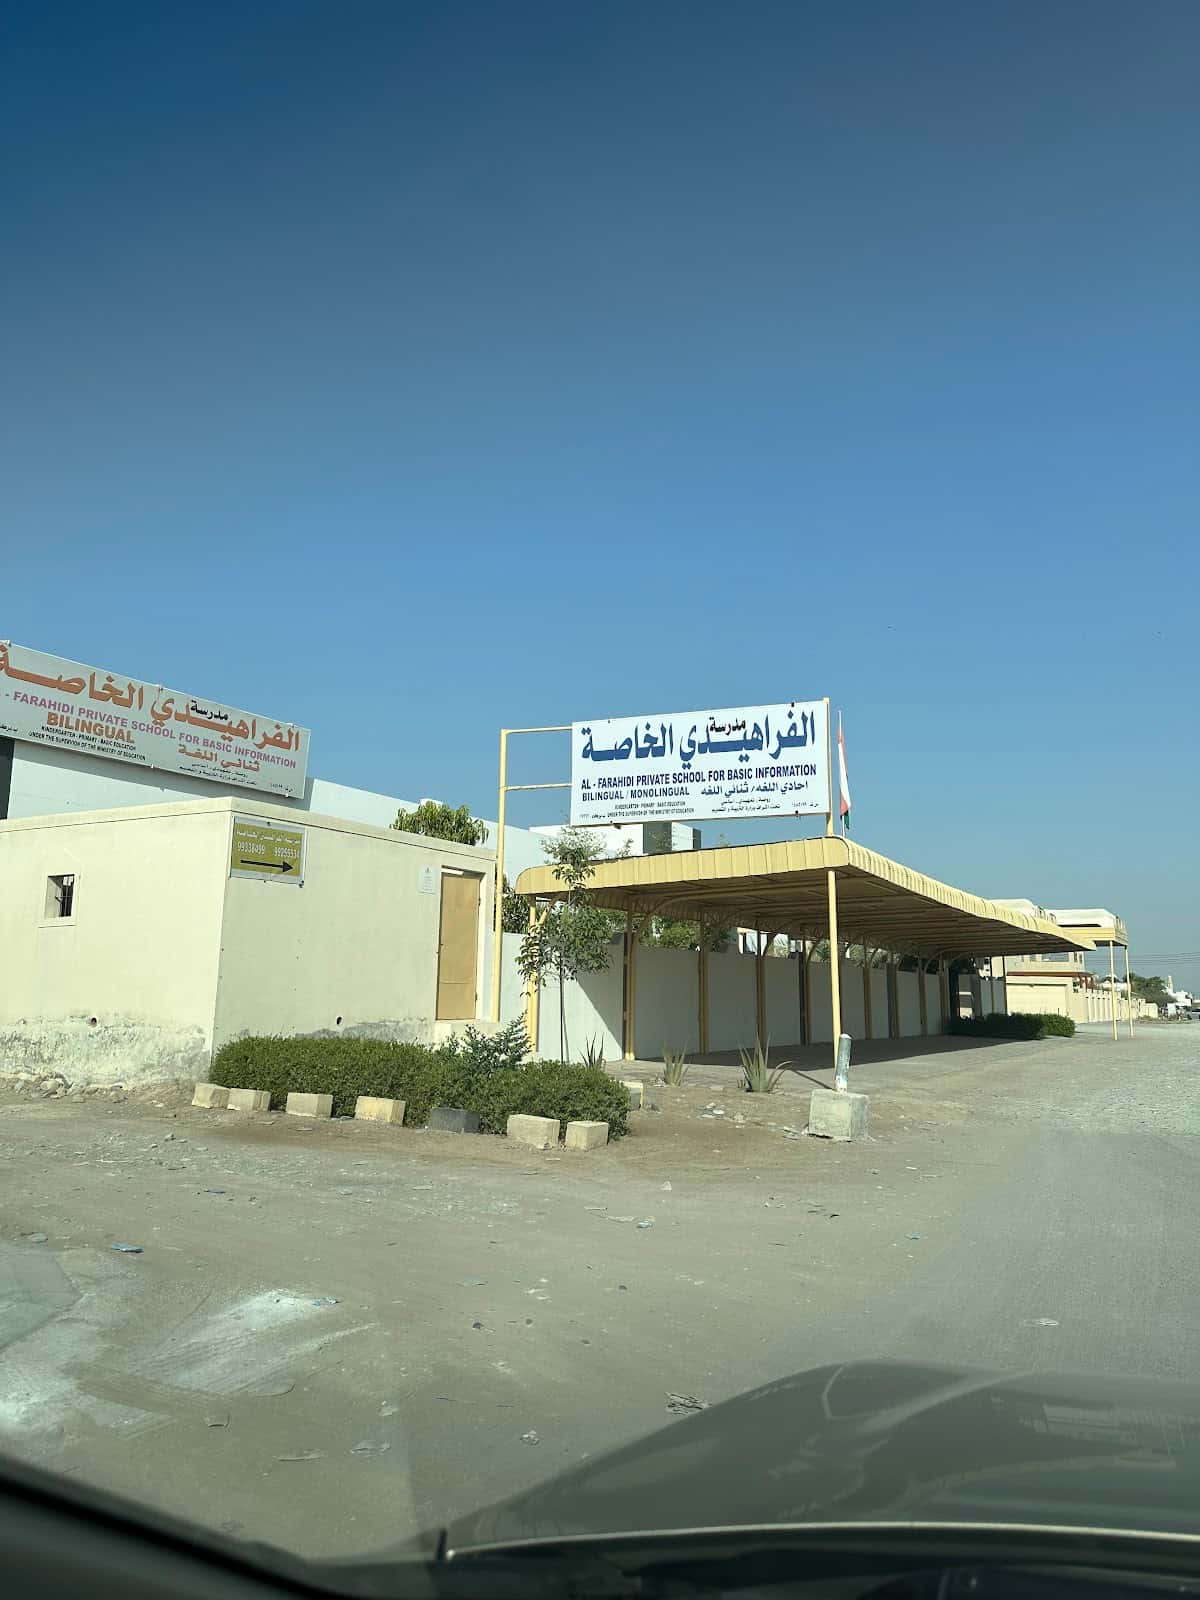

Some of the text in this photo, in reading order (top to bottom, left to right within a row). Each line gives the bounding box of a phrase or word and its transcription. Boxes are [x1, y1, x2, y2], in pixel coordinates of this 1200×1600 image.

[190, 699, 228, 720] مدرسة
[13, 691, 74, 715] FARAHIDI
[78, 707, 128, 727] PRIVATE
[131, 720, 176, 739] SCHOOL
[179, 732, 199, 745] FOR
[202, 739, 232, 753] BASIC
[234, 745, 296, 769] INFORMATION
[46, 711, 135, 744] BILINGUAL
[151, 698, 299, 751] الفراهيدي
[581, 709, 815, 770] مدرسة الفراهيدي الخاصة
[221, 758, 260, 772] ثنائي
[581, 779, 591, 790] AL
[597, 775, 634, 789] FARAHIDI
[636, 773, 670, 786] PRIVATE
[672, 771, 706, 784] SCHOOL
[708, 769, 725, 782] FOR
[727, 768, 753, 780] BASIC
[755, 764, 817, 779] INFORMATION
[582, 791, 624, 802] BILINGUAL
[630, 786, 690, 799] MONOLINGUAL
